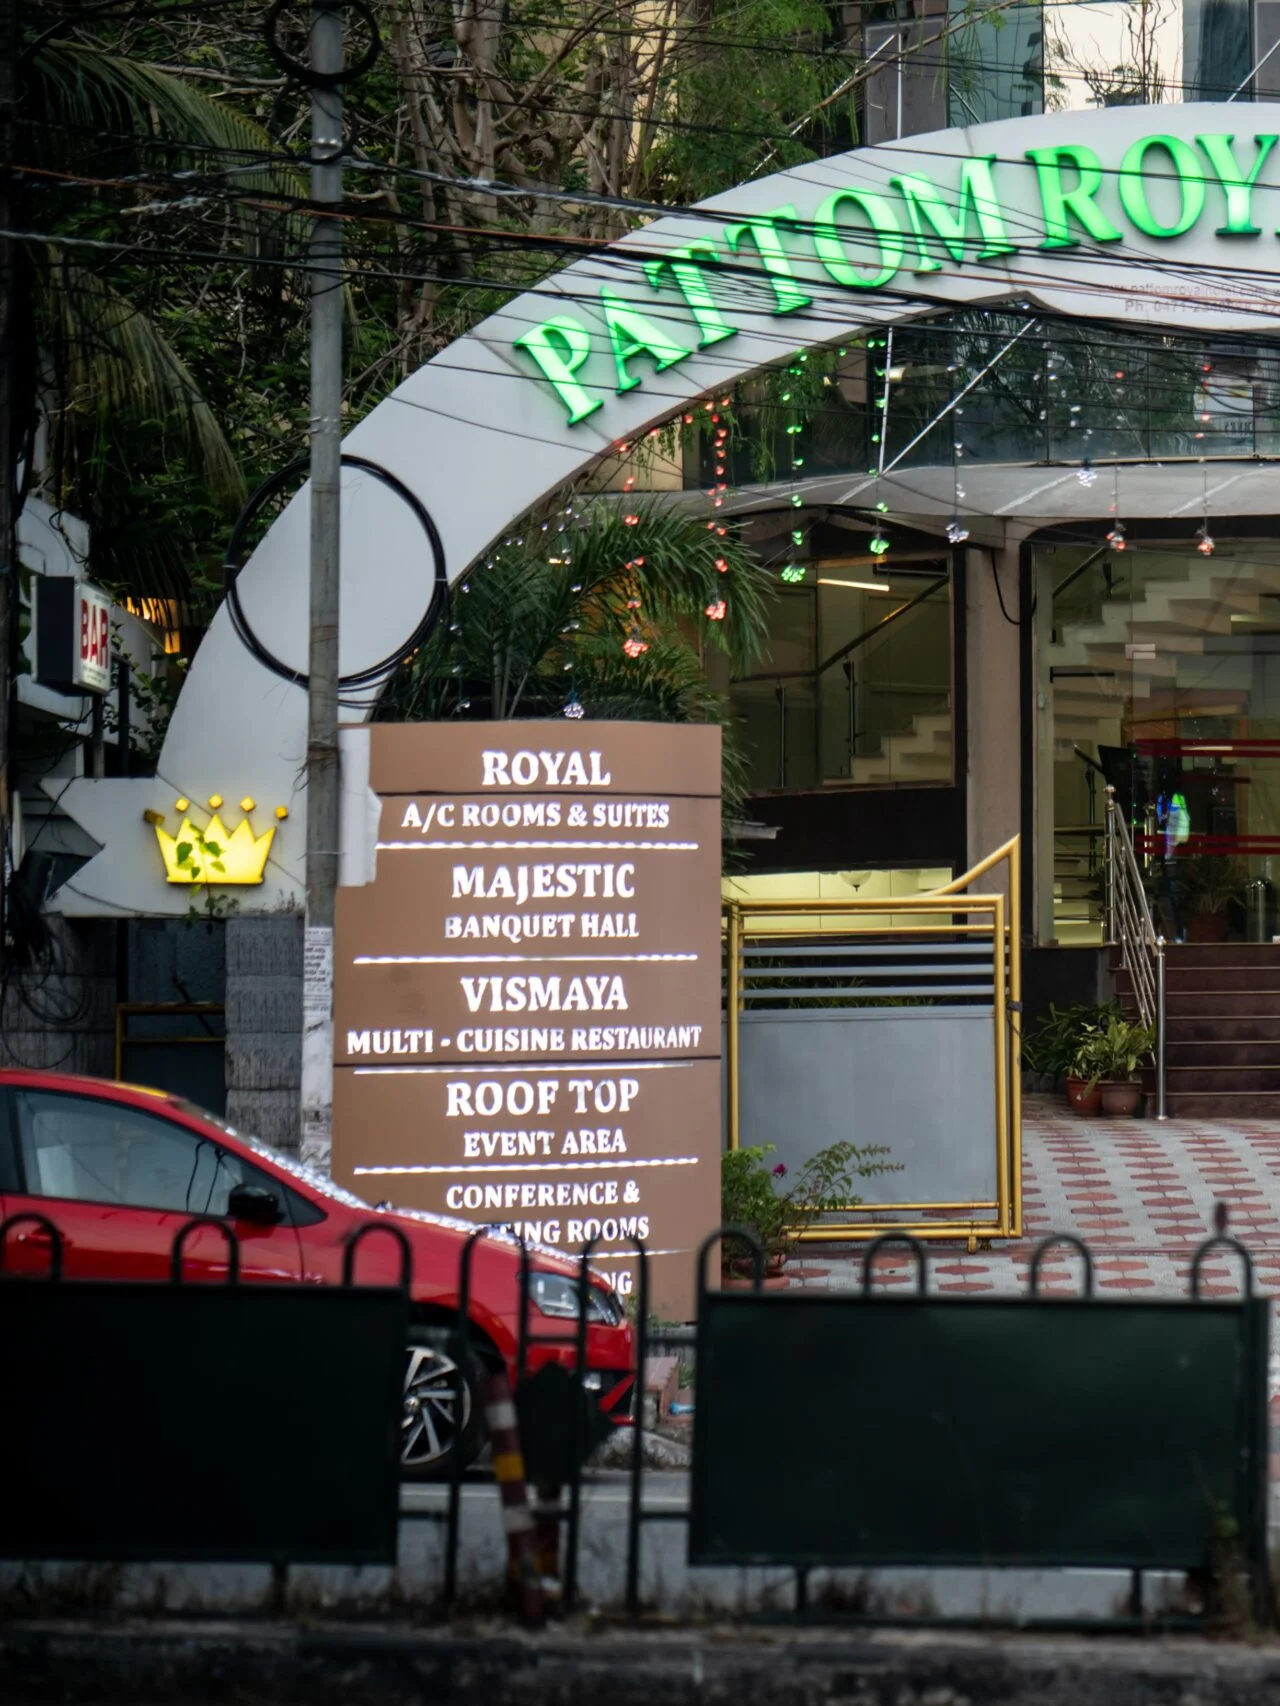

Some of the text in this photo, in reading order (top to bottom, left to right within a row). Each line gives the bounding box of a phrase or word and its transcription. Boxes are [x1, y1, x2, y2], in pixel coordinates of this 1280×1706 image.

[512, 151, 1018, 427] PATTOM
[79, 598, 110, 670] BAR
[481, 750, 611, 786] ROYAL
[401, 803, 670, 833] A/C ROOMS & SUITES
[451, 863, 635, 905] MAJESTIC
[444, 913, 640, 943] BANQUET HALL
[460, 975, 629, 1012] VISMAYA
[346, 1029, 434, 1055] MULTI
[456, 1027, 565, 1053] CUISINE
[571, 1025, 702, 1051] RESTAURANT
[446, 1078, 640, 1117] ROOF TOP
[463, 1128, 628, 1158] EVENT AREA
[446, 1179, 641, 1210] CONFERENCE &
[566, 1215, 650, 1243] ROOMS
